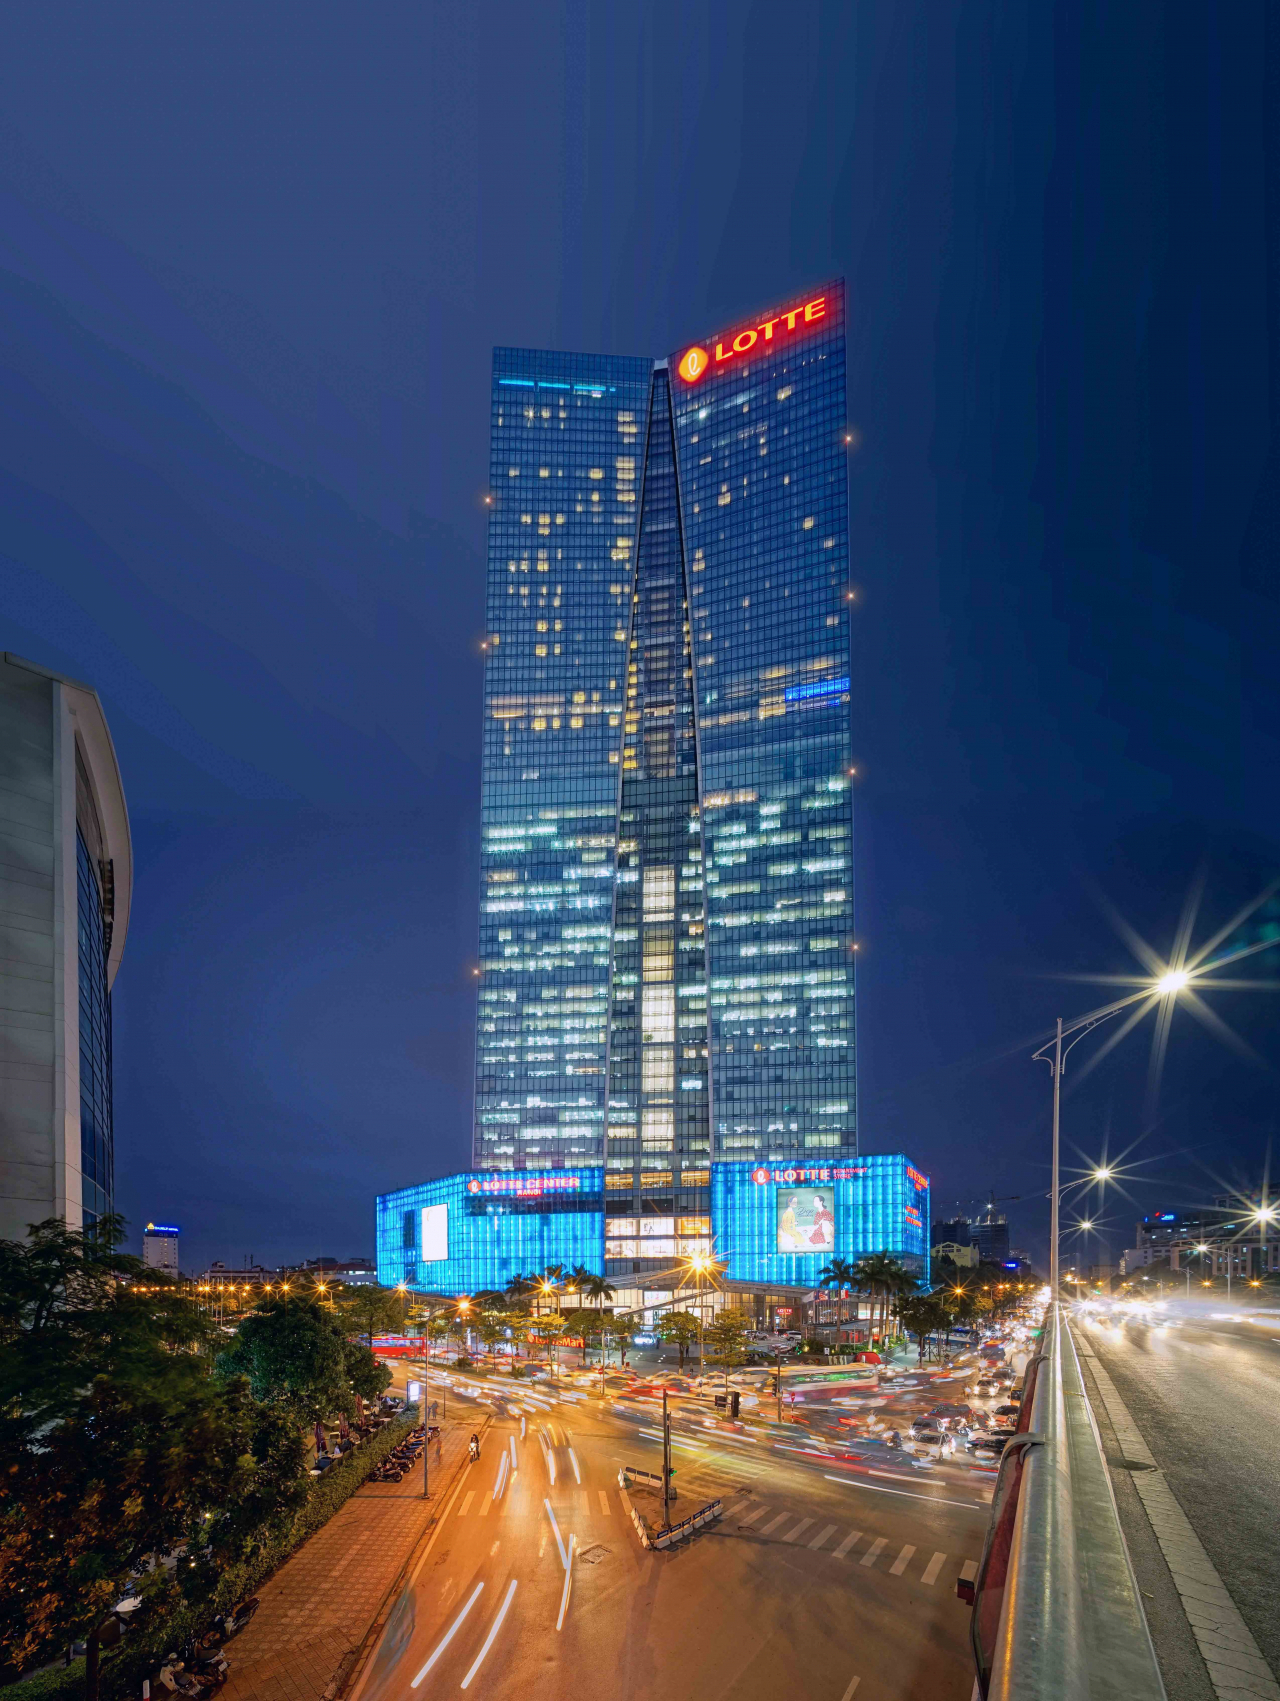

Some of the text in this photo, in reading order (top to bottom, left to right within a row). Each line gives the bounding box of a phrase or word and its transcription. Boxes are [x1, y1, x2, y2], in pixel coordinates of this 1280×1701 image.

[716, 297, 825, 361] LOTTE
[775, 1168, 830, 1180] LOTTE
[483, 1177, 580, 1190] LOTTE CENTER
